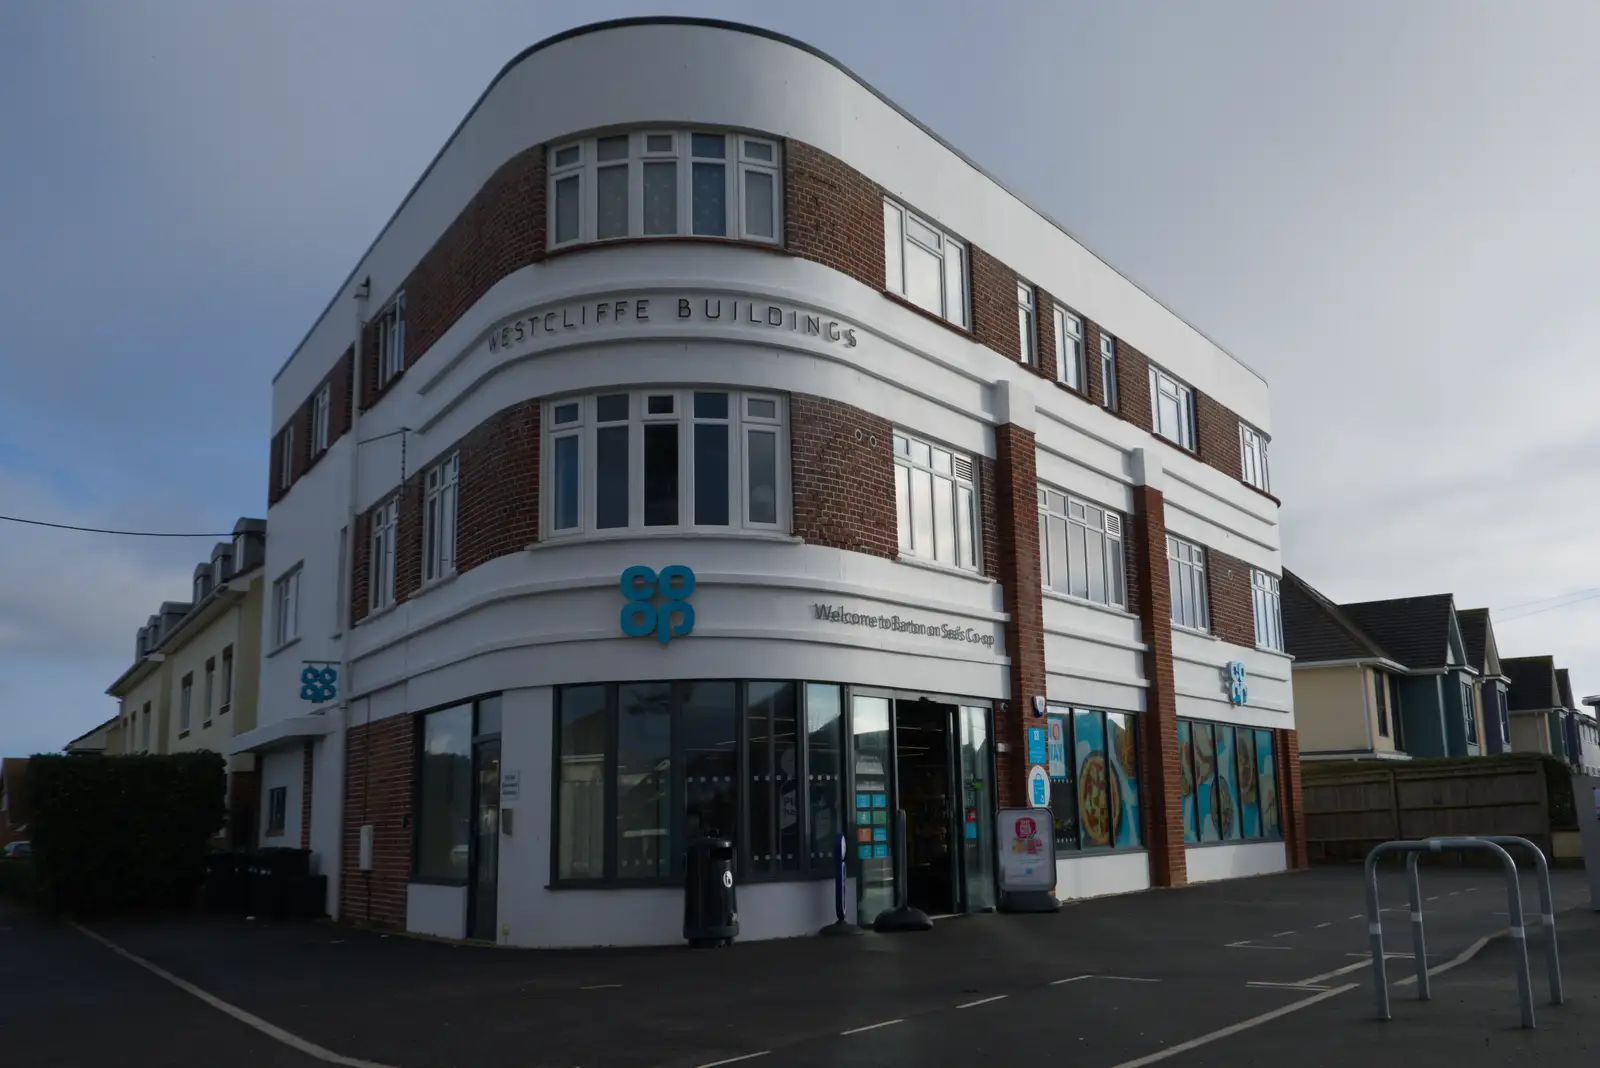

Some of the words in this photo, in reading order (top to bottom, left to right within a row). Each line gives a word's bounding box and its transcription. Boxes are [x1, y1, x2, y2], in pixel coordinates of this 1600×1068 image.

[488, 300, 650, 353] WESTCLIFFE
[677, 298, 858, 348] BUILDINGS
[814, 603, 877, 628] Welcome
[879, 615, 892, 630] to
[891, 615, 926, 636] Barton
[926, 625, 941, 637] on
[965, 627, 995, 649] Co-op
